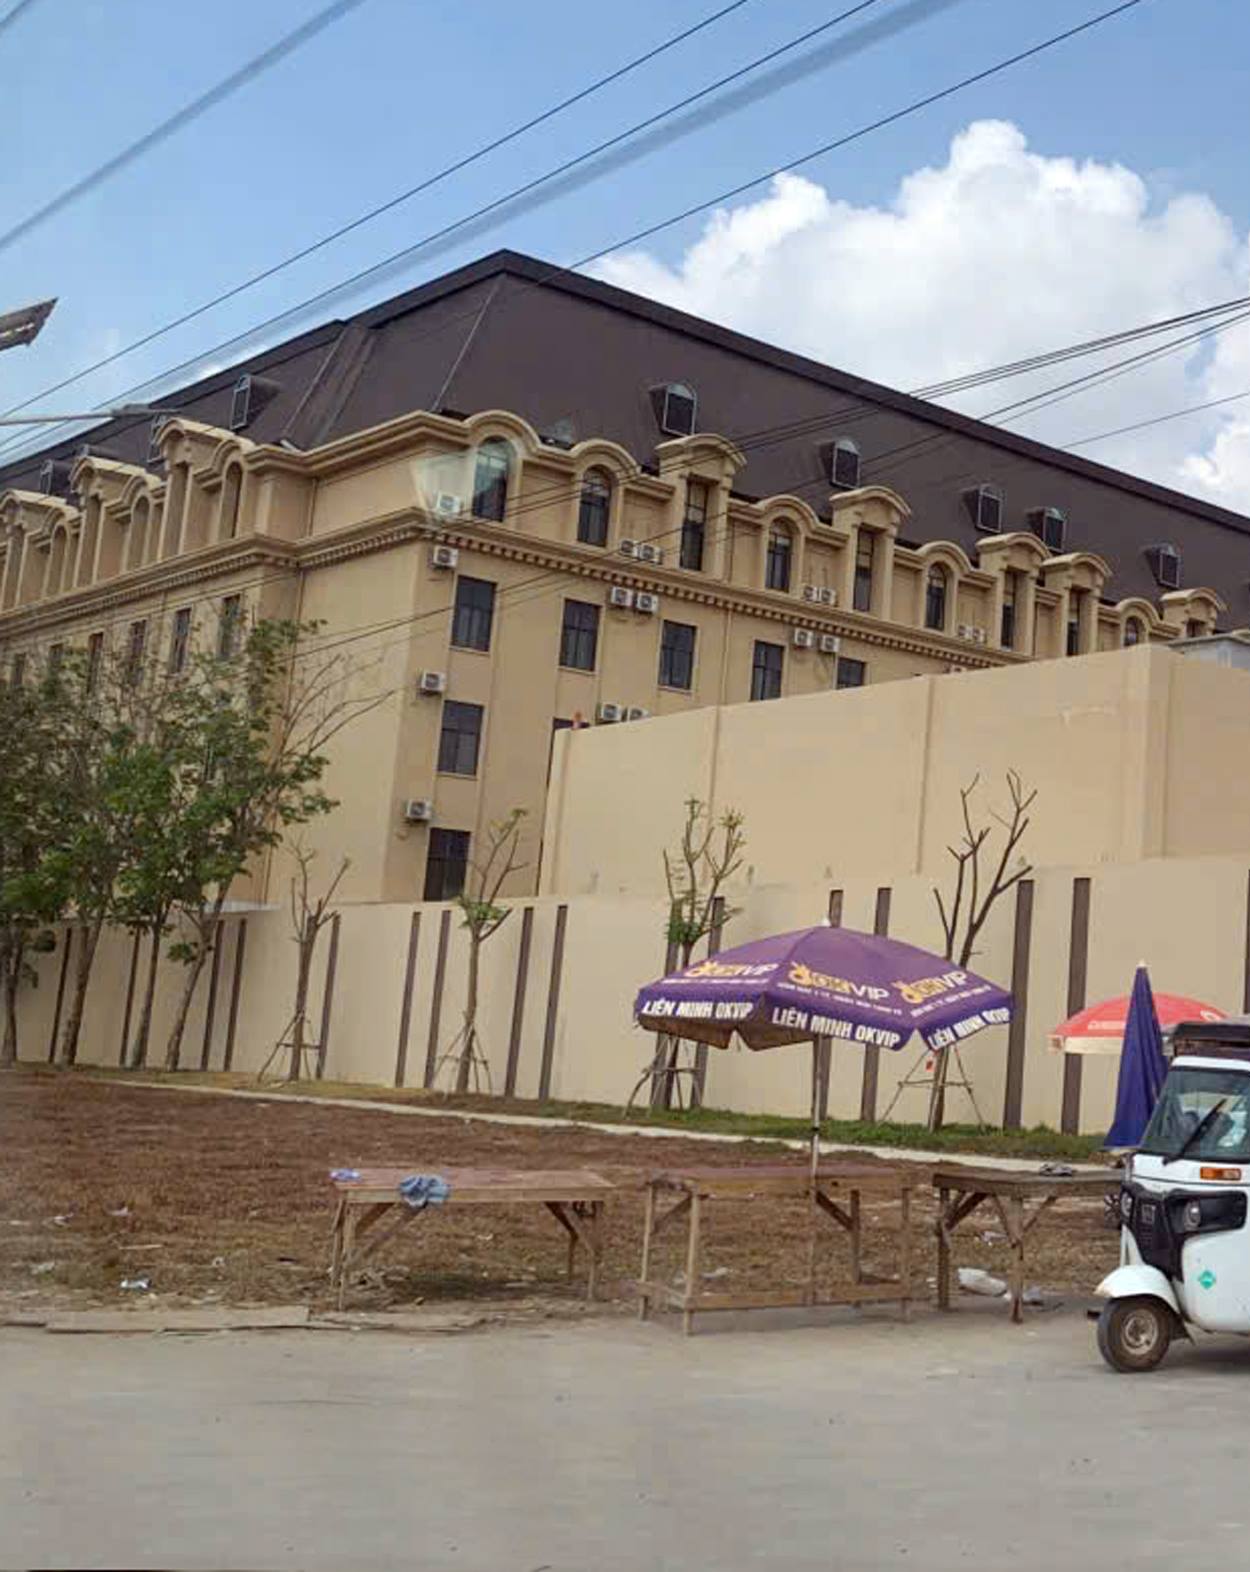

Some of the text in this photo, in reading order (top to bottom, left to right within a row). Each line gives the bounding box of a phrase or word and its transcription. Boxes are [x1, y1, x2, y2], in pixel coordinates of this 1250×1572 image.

[641, 997, 754, 1019] LIÊN MINH OKVIP
[772, 1007, 900, 1048] LIÊN MINH OKVIP
